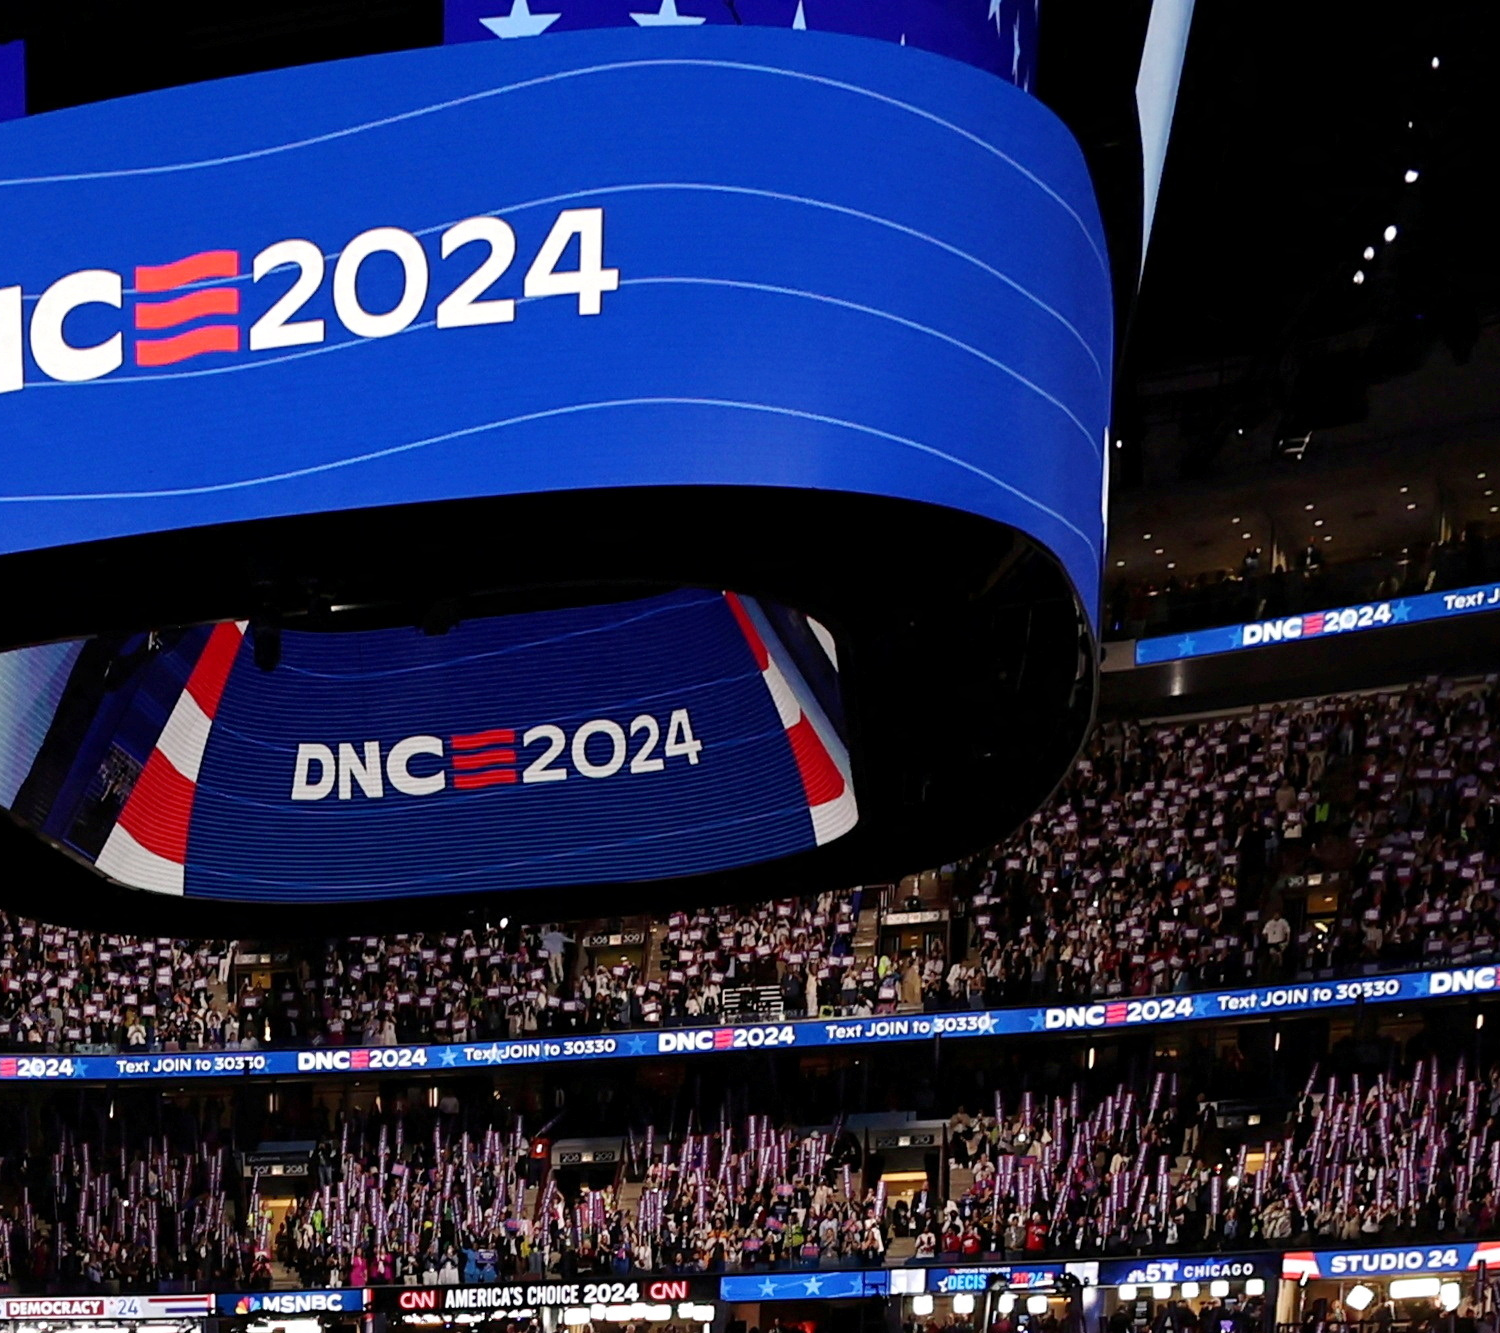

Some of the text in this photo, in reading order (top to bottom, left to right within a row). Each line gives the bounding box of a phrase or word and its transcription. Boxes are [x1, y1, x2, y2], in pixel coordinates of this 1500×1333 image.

[250, 208, 619, 350] 2024
[1444, 592, 1484, 609] Text
[291, 708, 702, 800] DNC 2024
[1218, 994, 1257, 1010] Text
[1261, 989, 1307, 1006] JOIN
[1313, 988, 1331, 1001] to
[1184, 1263, 1254, 1278] CHICAGO
[1331, 1249, 1458, 1273] STUDIO 24
[262, 1294, 342, 1314] MSNBC
[400, 1281, 687, 1310] CNN AMERICA'S CHOICE 2024 CNN
[9, 1300, 101, 1316] DEMOCRACY
